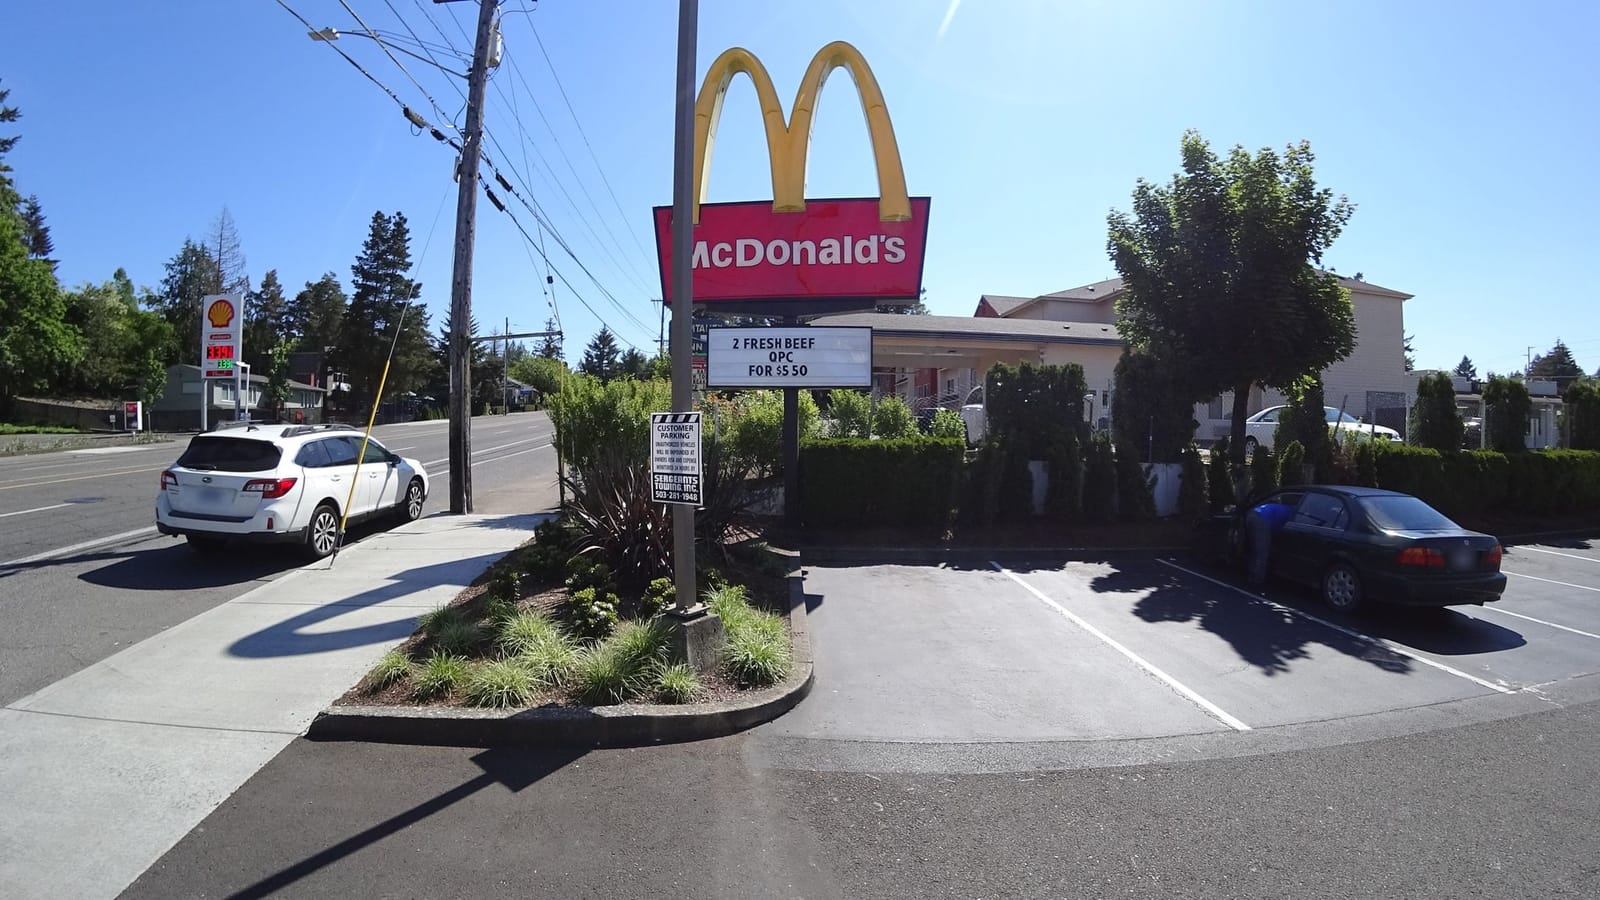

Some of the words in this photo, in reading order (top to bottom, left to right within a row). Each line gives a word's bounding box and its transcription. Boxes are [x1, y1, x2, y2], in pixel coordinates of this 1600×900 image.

[732, 338, 740, 350] 2
[743, 338, 782, 349] FRESH
[785, 337, 816, 349] BEEF
[769, 351, 794, 363] QPC
[749, 365, 773, 377] FOR
[655, 491, 698, 501] 503-281-1948
